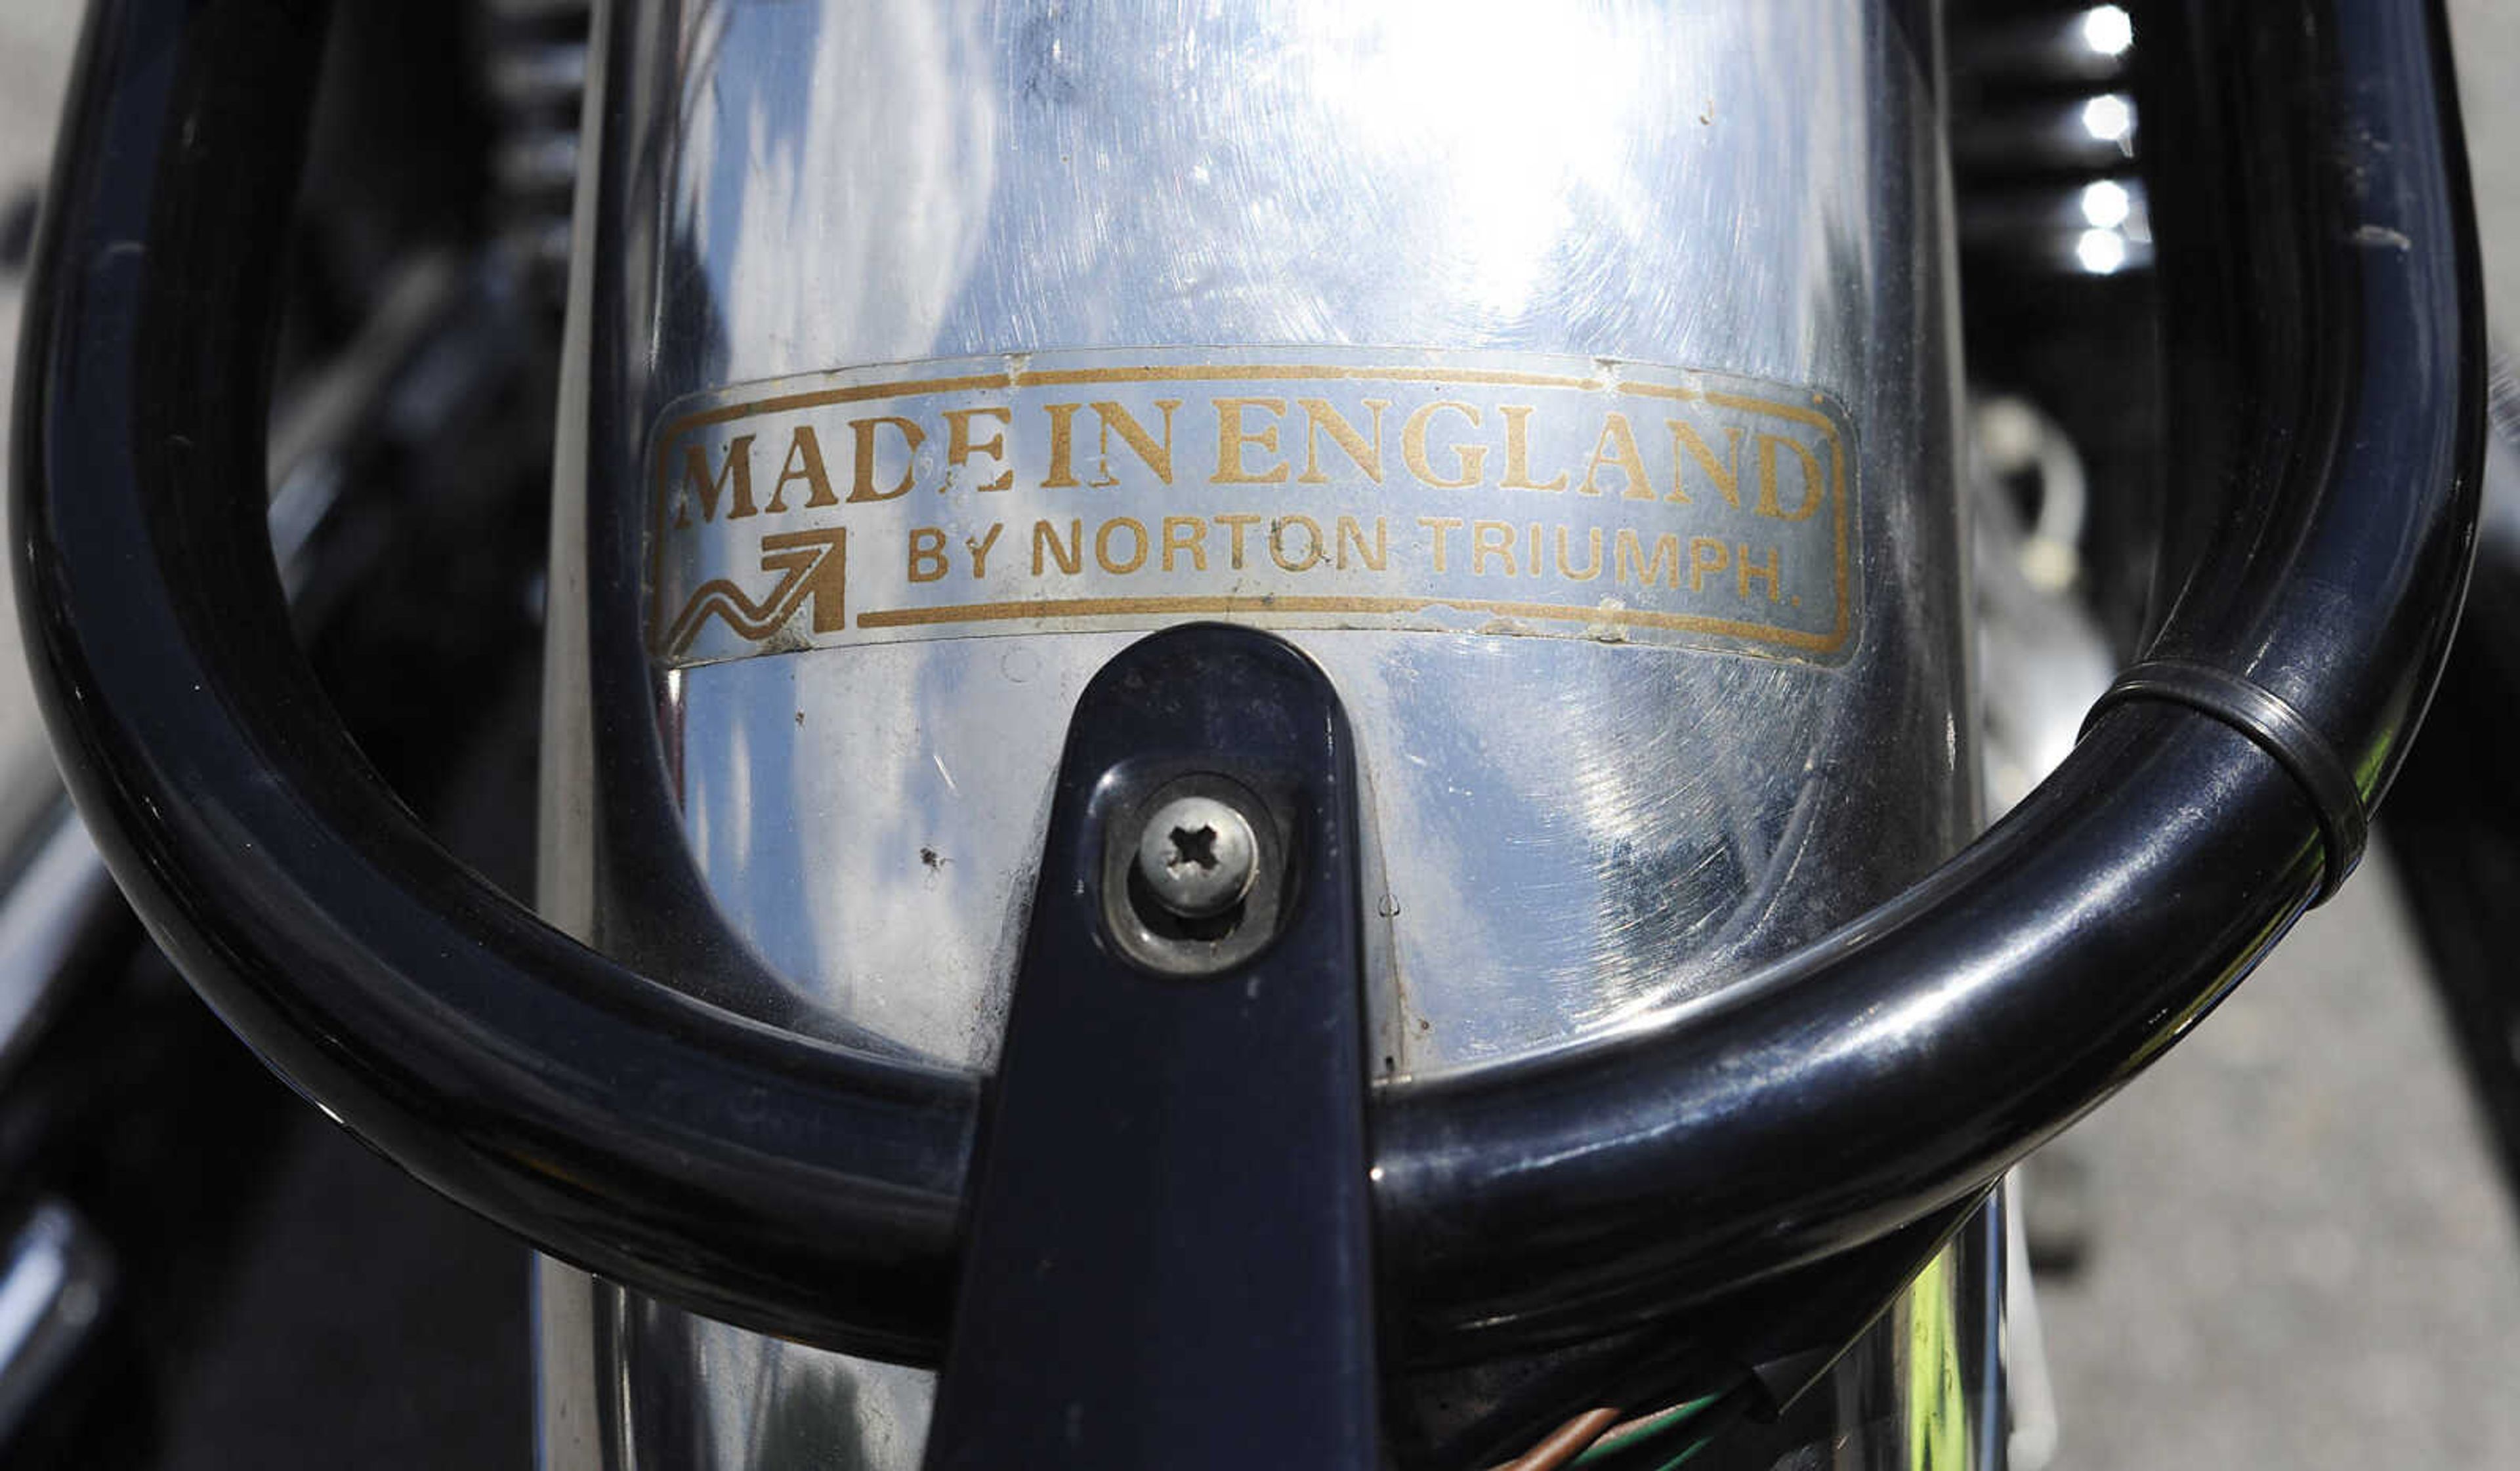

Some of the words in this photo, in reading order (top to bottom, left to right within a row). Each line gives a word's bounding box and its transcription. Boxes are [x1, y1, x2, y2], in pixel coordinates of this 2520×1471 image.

[676, 407, 1014, 526] MADE
[1041, 400, 1182, 489] IN
[1209, 398, 1824, 522] ENGLAND
[907, 522, 1004, 583] BY
[1031, 515, 1388, 576] NORTON
[1418, 517, 1801, 607] TRIUMPH.
